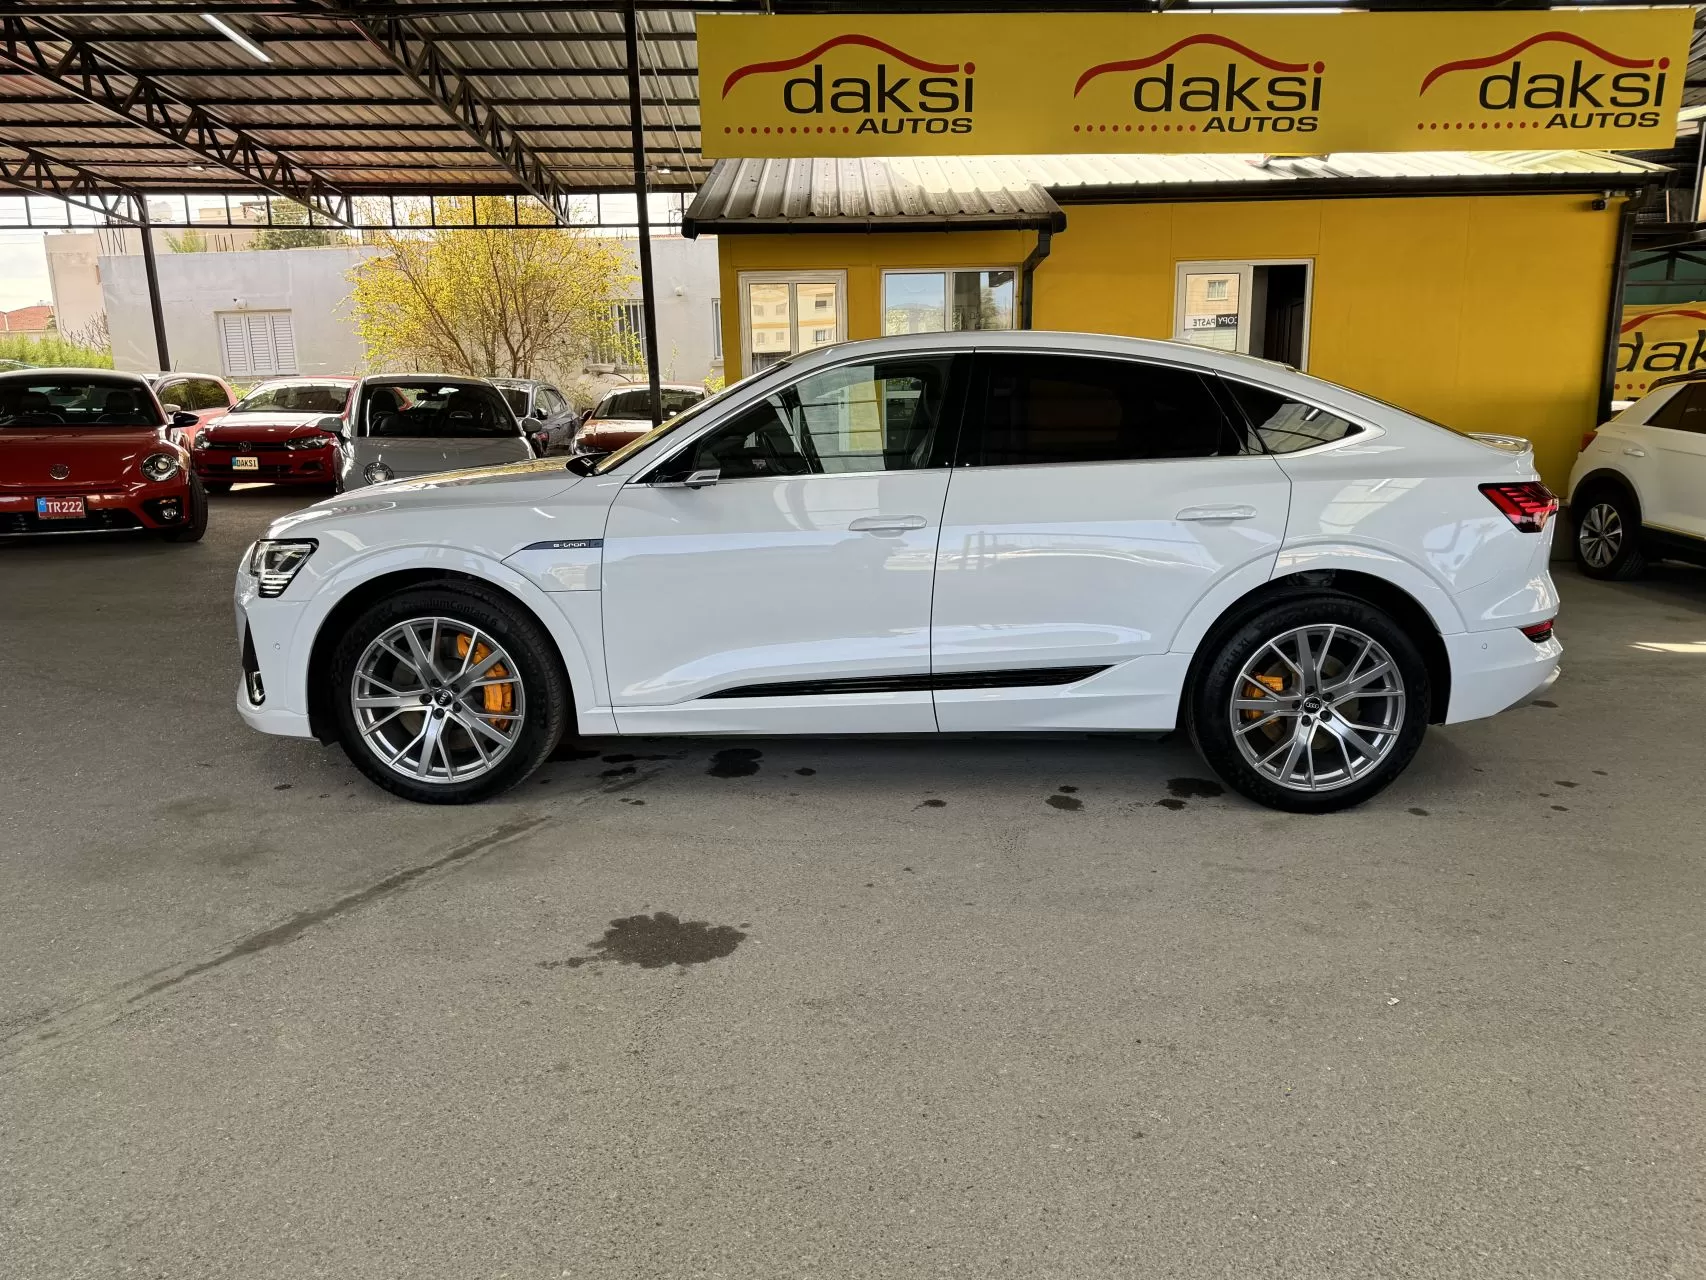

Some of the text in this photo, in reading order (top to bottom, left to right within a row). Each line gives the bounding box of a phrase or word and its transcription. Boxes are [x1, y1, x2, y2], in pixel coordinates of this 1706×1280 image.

[783, 62, 976, 114] daksi
[1133, 61, 1326, 112] daksi
[1479, 57, 1671, 110] daksi
[855, 118, 973, 134] AUTOS
[1202, 116, 1318, 133] AUTOS
[1545, 112, 1660, 129] AUTOS
[236, 459, 257, 468] DAKSI
[46, 501, 83, 513] TR222
[553, 541, 587, 549] e-tron
